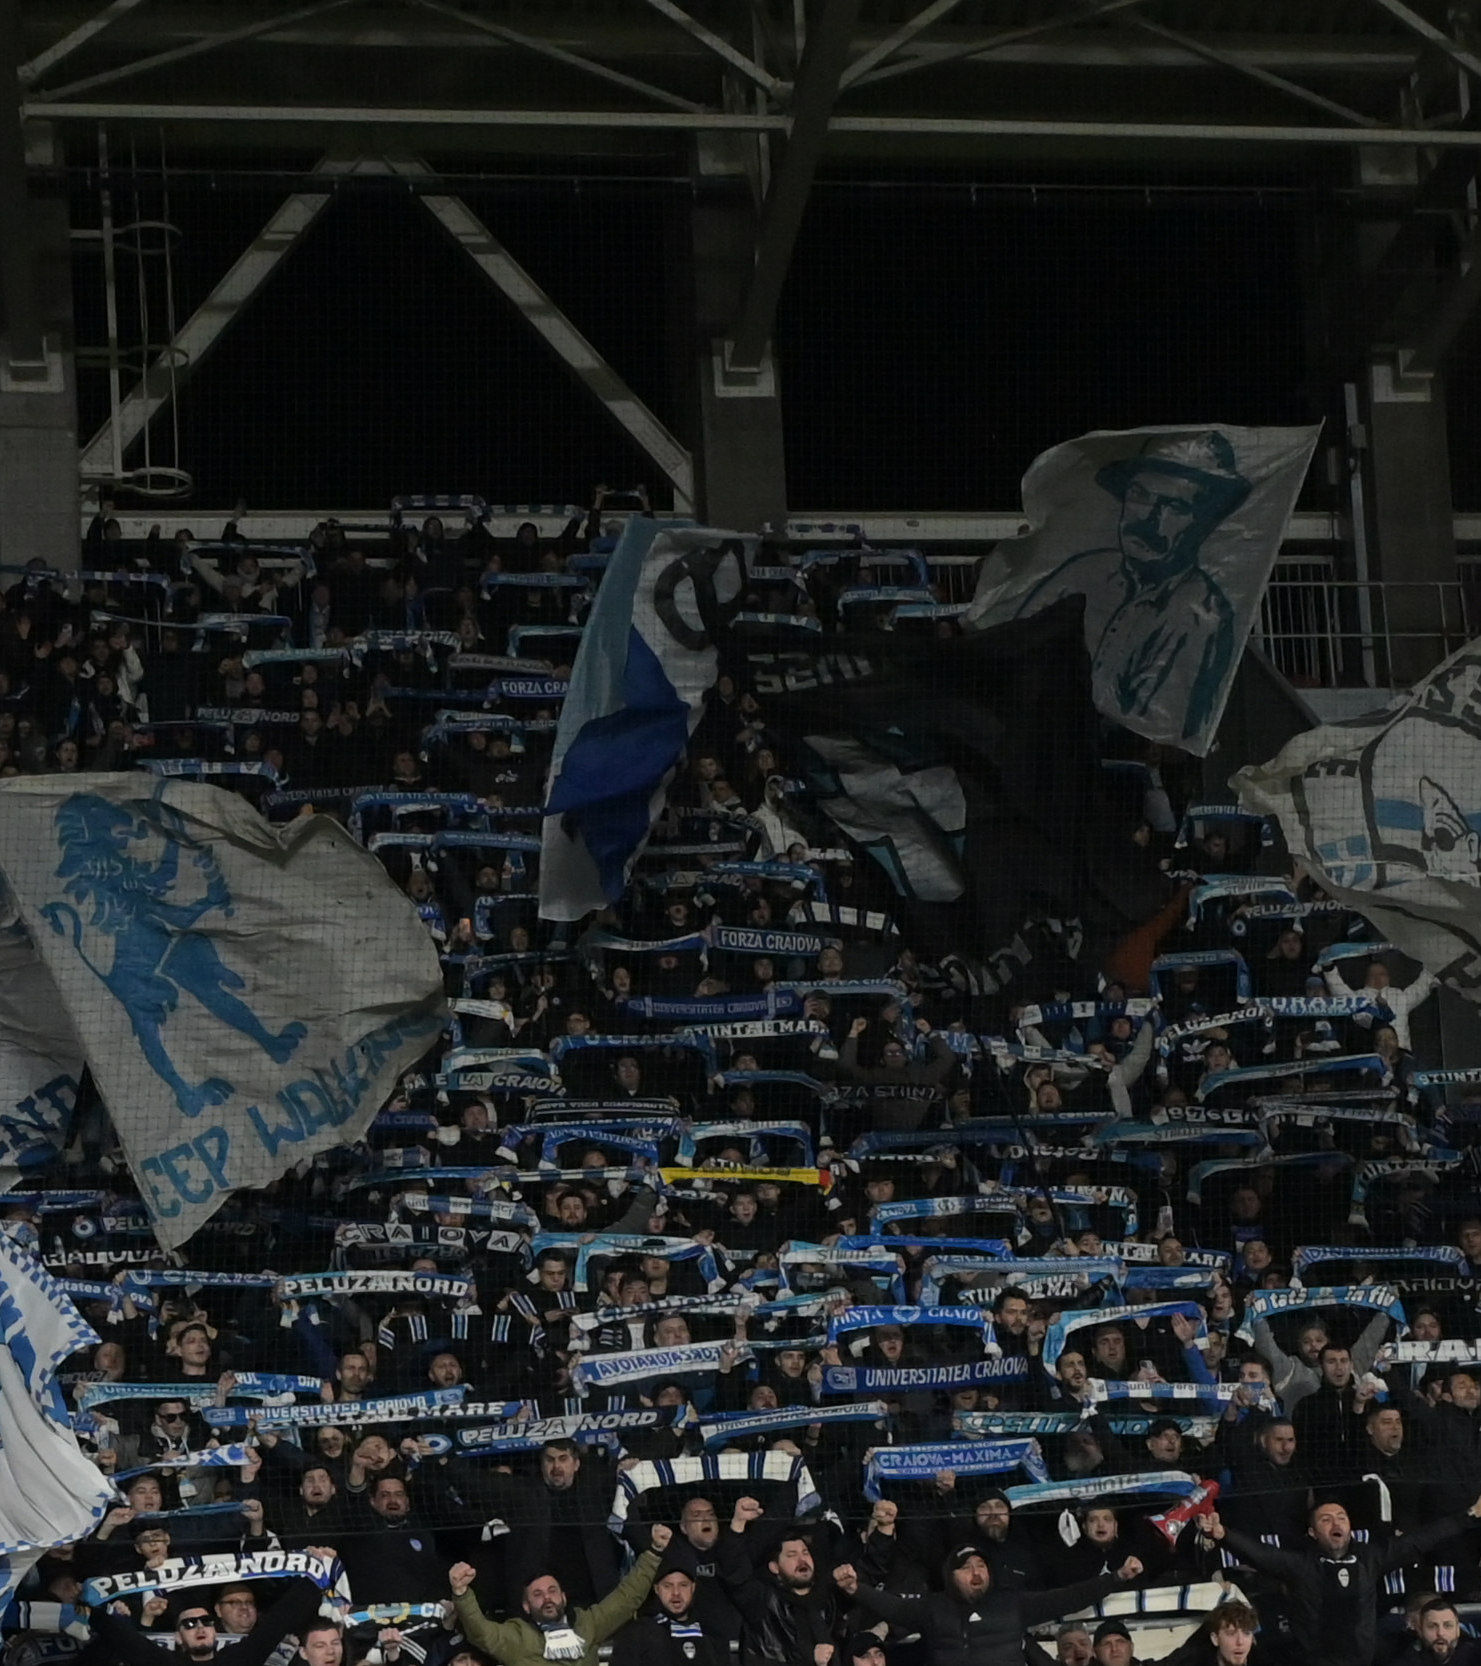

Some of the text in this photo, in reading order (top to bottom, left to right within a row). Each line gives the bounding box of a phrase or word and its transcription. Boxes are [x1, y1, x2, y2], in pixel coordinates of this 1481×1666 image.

[502, 680, 534, 696] FORZA
[721, 930, 822, 954] FORZA CRAIOVA
[340, 1221, 519, 1253] CRAIOVA
[283, 1276, 470, 1298] PELUZA NORD
[866, 1355, 1030, 1388] UNIVERSITATEA CRAIOVA
[244, 1401, 360, 1421] UNIVERSITATEA
[411, 1401, 504, 1417] MARE
[462, 1411, 658, 1447] PELUZA NORD
[237, 1550, 326, 1577] NORD
